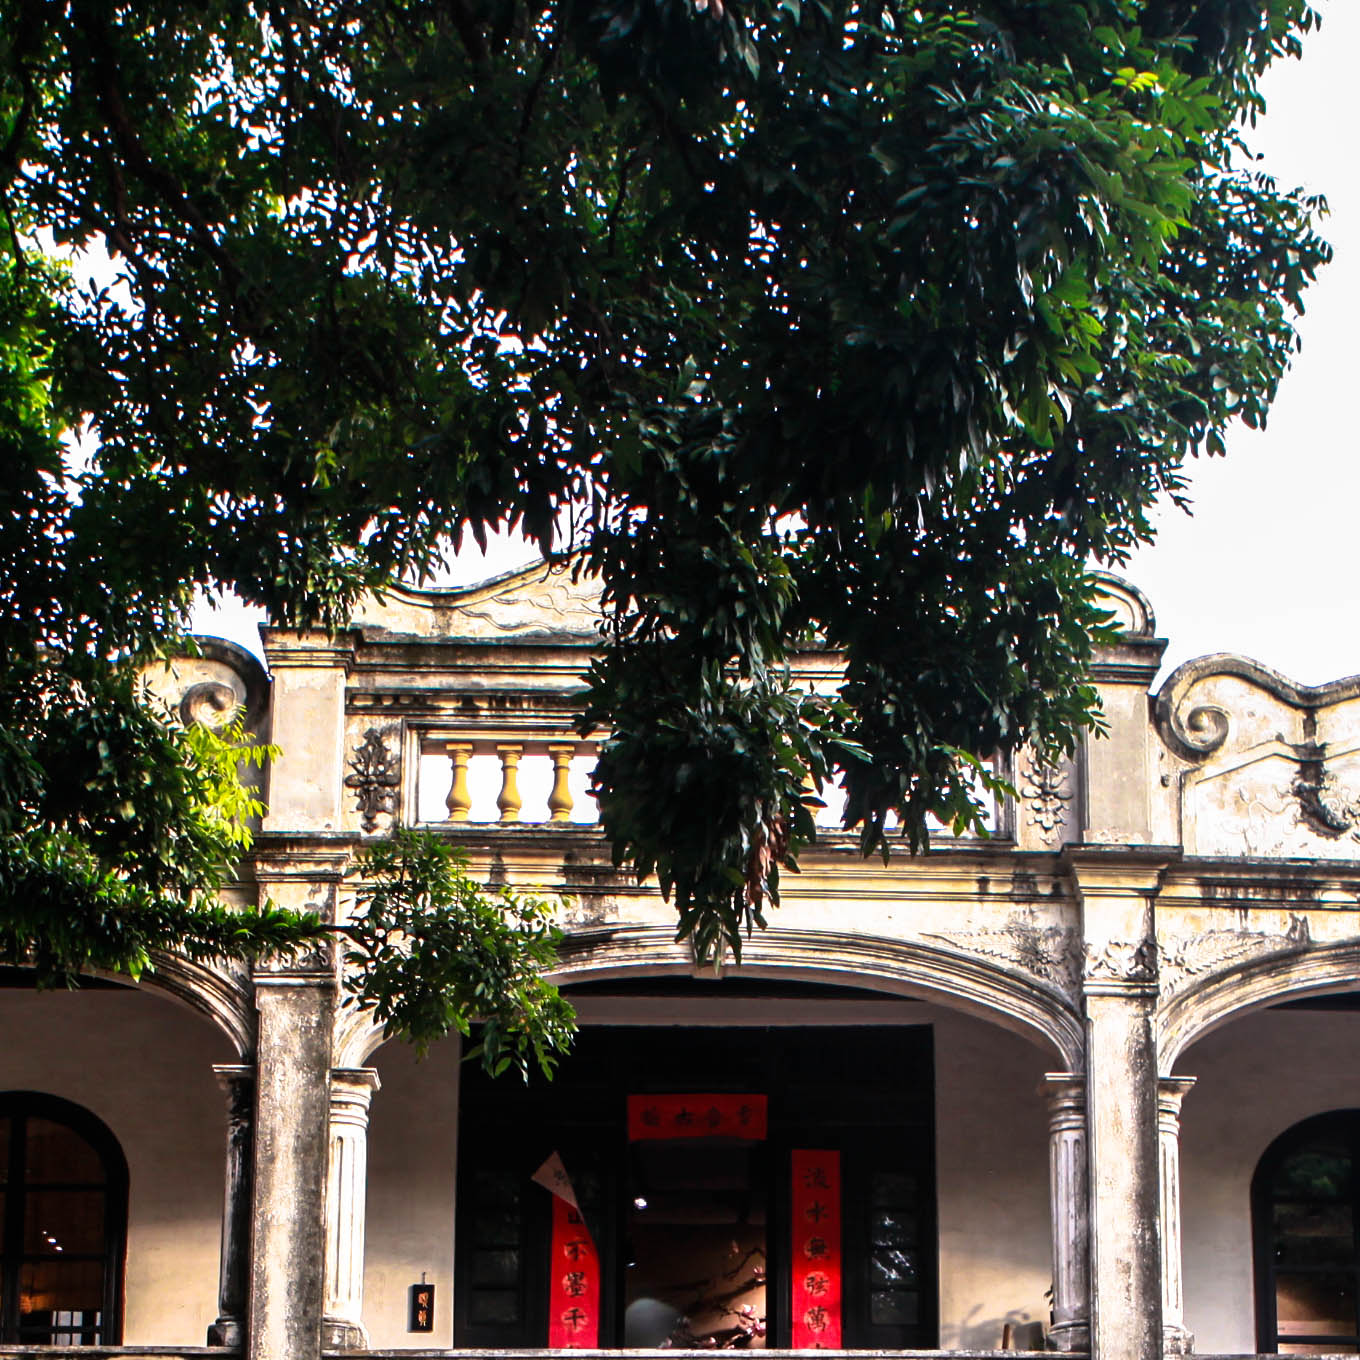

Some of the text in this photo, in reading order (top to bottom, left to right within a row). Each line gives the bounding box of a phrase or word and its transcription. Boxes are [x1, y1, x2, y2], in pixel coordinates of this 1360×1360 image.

[802, 1167, 831, 1348] 淡水無弦萬
